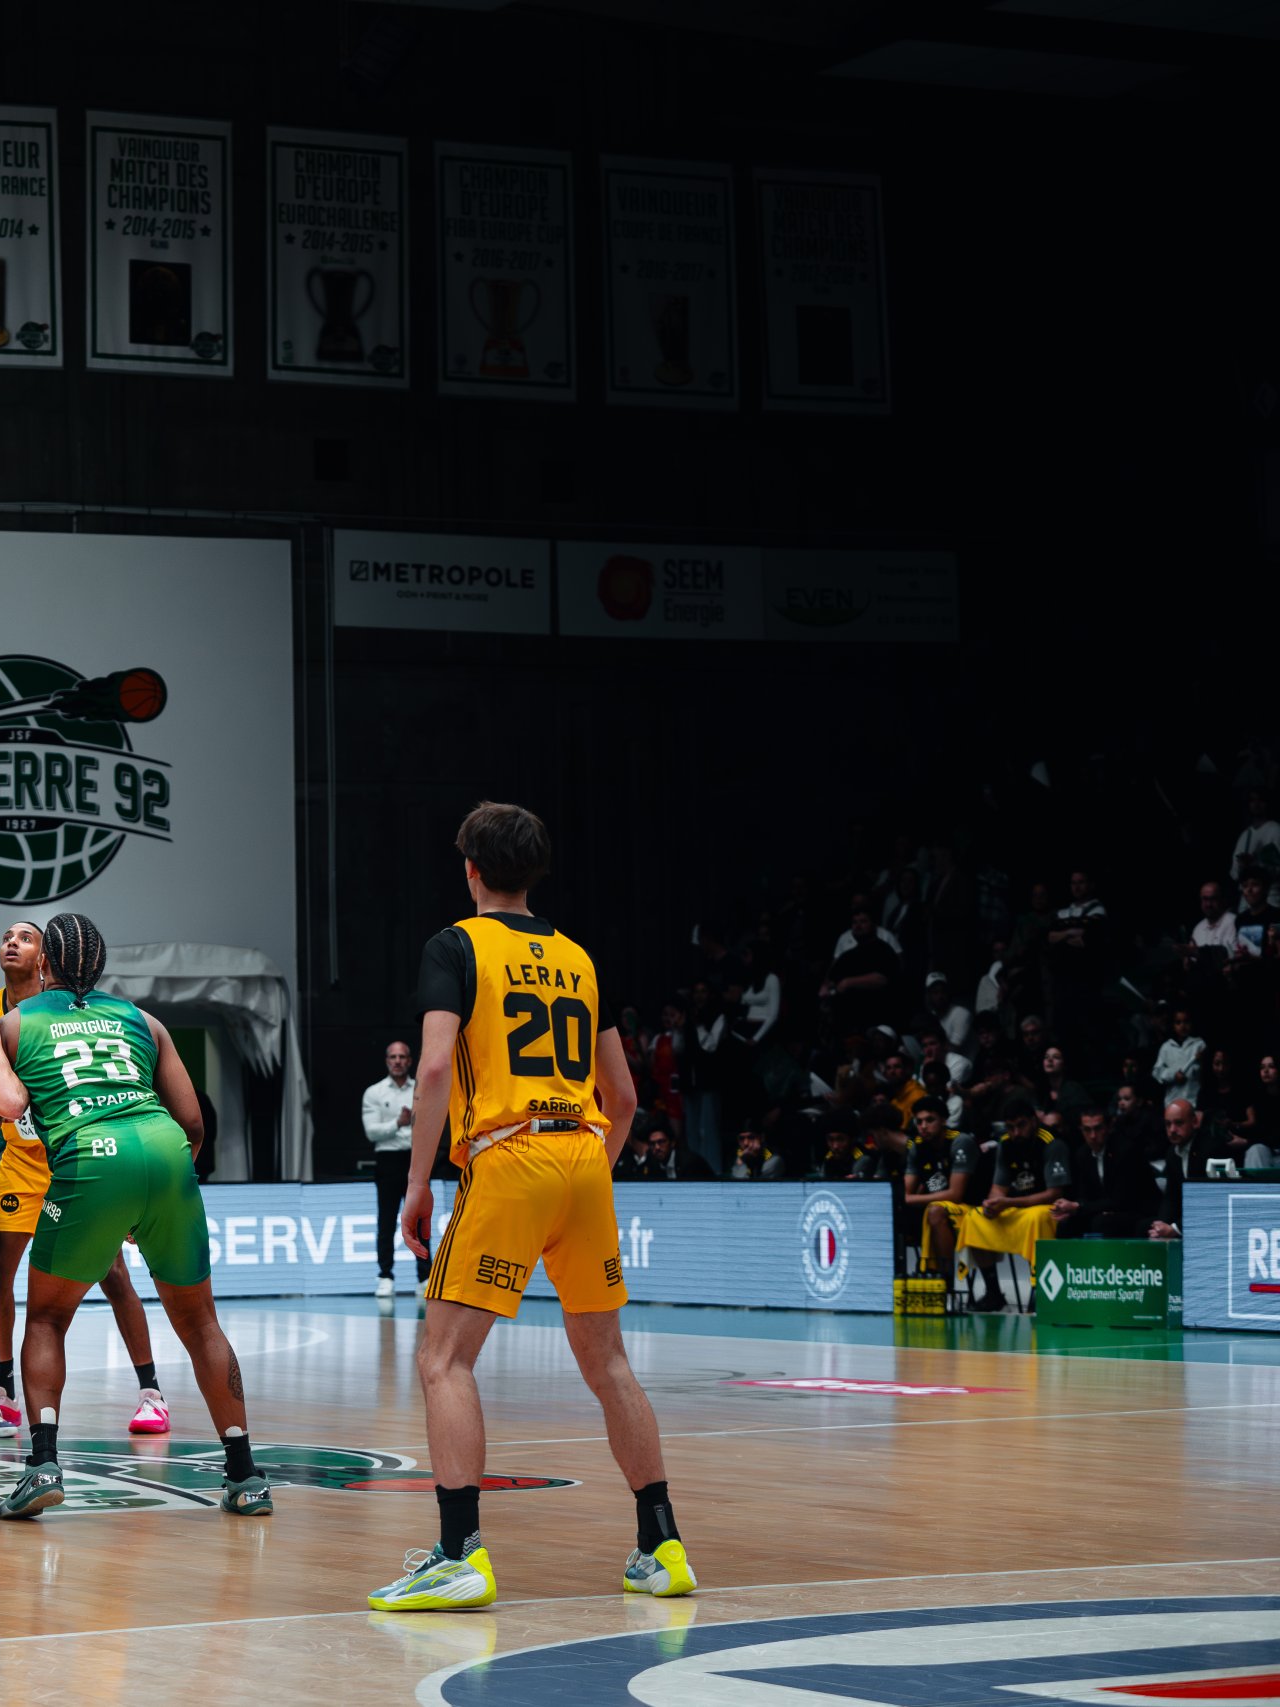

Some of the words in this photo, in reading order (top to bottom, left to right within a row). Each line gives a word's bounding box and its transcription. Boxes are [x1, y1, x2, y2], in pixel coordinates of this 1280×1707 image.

[118, 137, 199, 161] VAINQUEUR
[110, 159, 168, 186] MATCH
[177, 162, 208, 189] DES
[294, 151, 380, 179] CHAMPION
[108, 185, 211, 215] CHAMPIONS
[295, 175, 380, 205] D'EUROPE
[122, 216, 195, 239] 2014-2015
[278, 203, 399, 232] EUROCHALLENGE
[302, 230, 373, 252] 2014-2015
[372, 561, 535, 589] METROPOLE
[663, 559, 724, 590] SEEM
[9, 730, 32, 741] JSF
[114, 762, 170, 832] 92
[6, 819, 37, 830] 1927
[505, 964, 581, 993] LERAY
[49, 1019, 125, 1039] RODRIGUEZ
[503, 992, 591, 1082] 20
[53, 1038, 141, 1089] 23
[92, 1137, 118, 1157] 23
[2, 1200, 18, 1208] RAS
[475, 1268, 522, 1293] SOL
[1067, 1287, 1117, 1302] Département
[1118, 1288, 1145, 1304] Sportif
